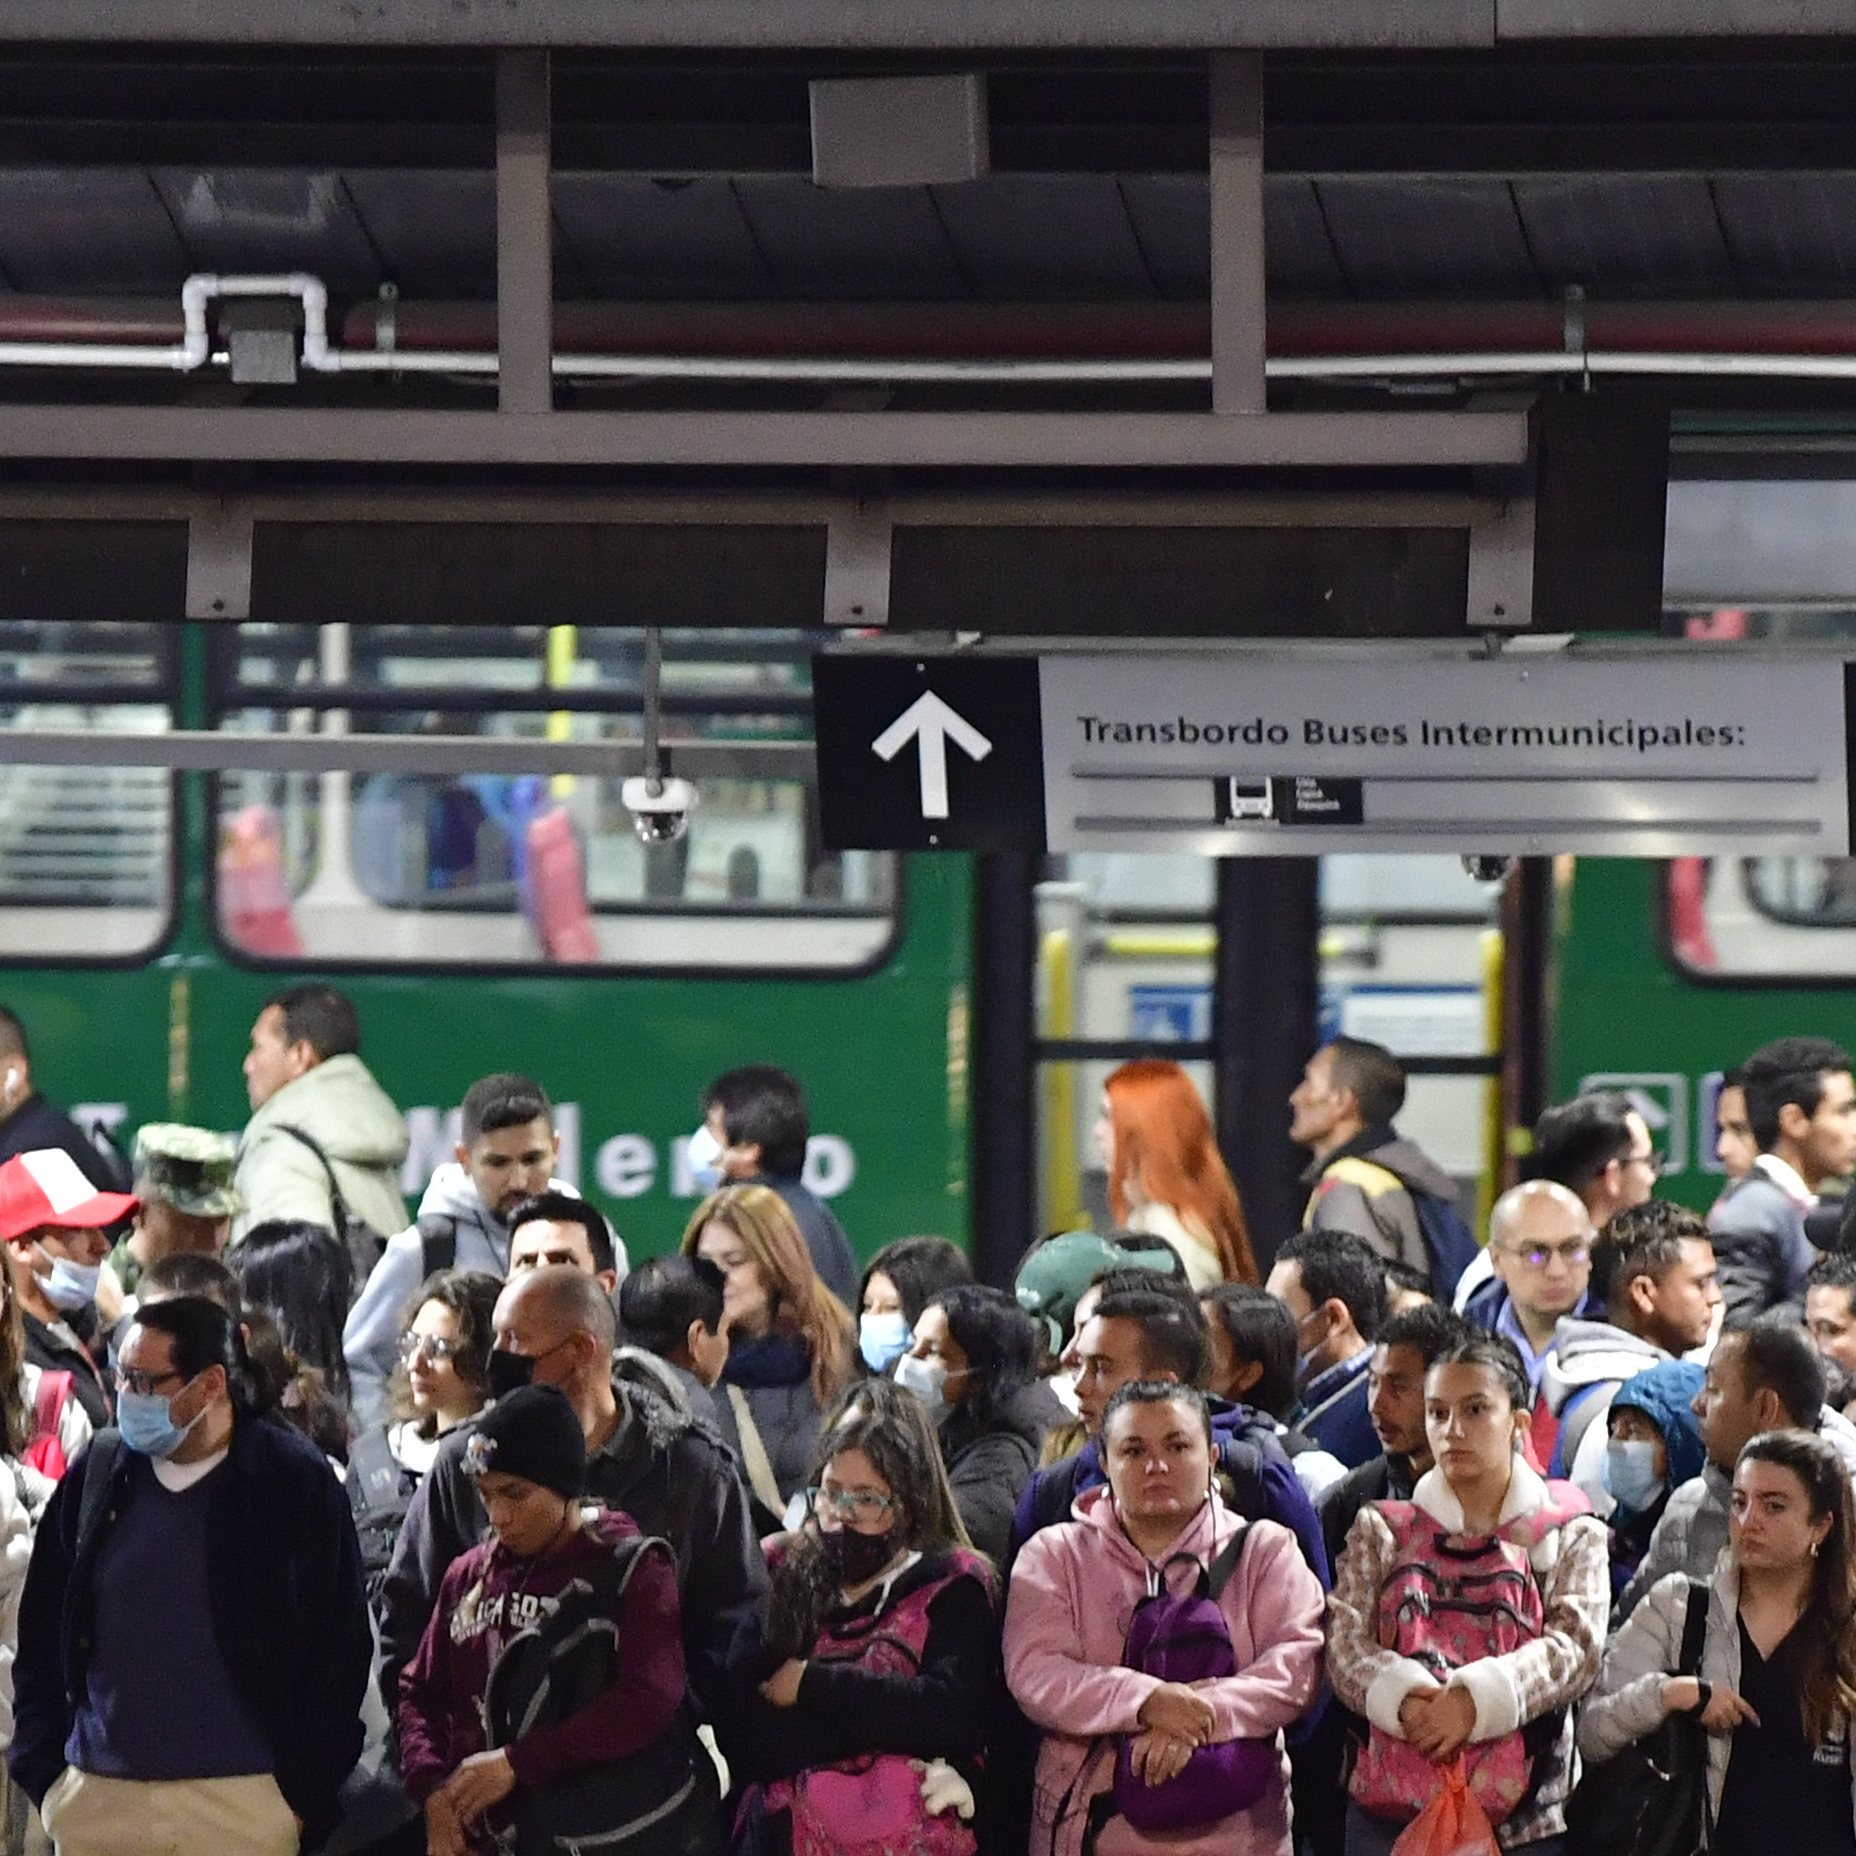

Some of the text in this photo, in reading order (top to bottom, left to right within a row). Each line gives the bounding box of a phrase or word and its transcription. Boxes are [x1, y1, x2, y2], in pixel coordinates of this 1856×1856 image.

[1077, 716, 1744, 752] Transbordo Buses Intermunicipales:
